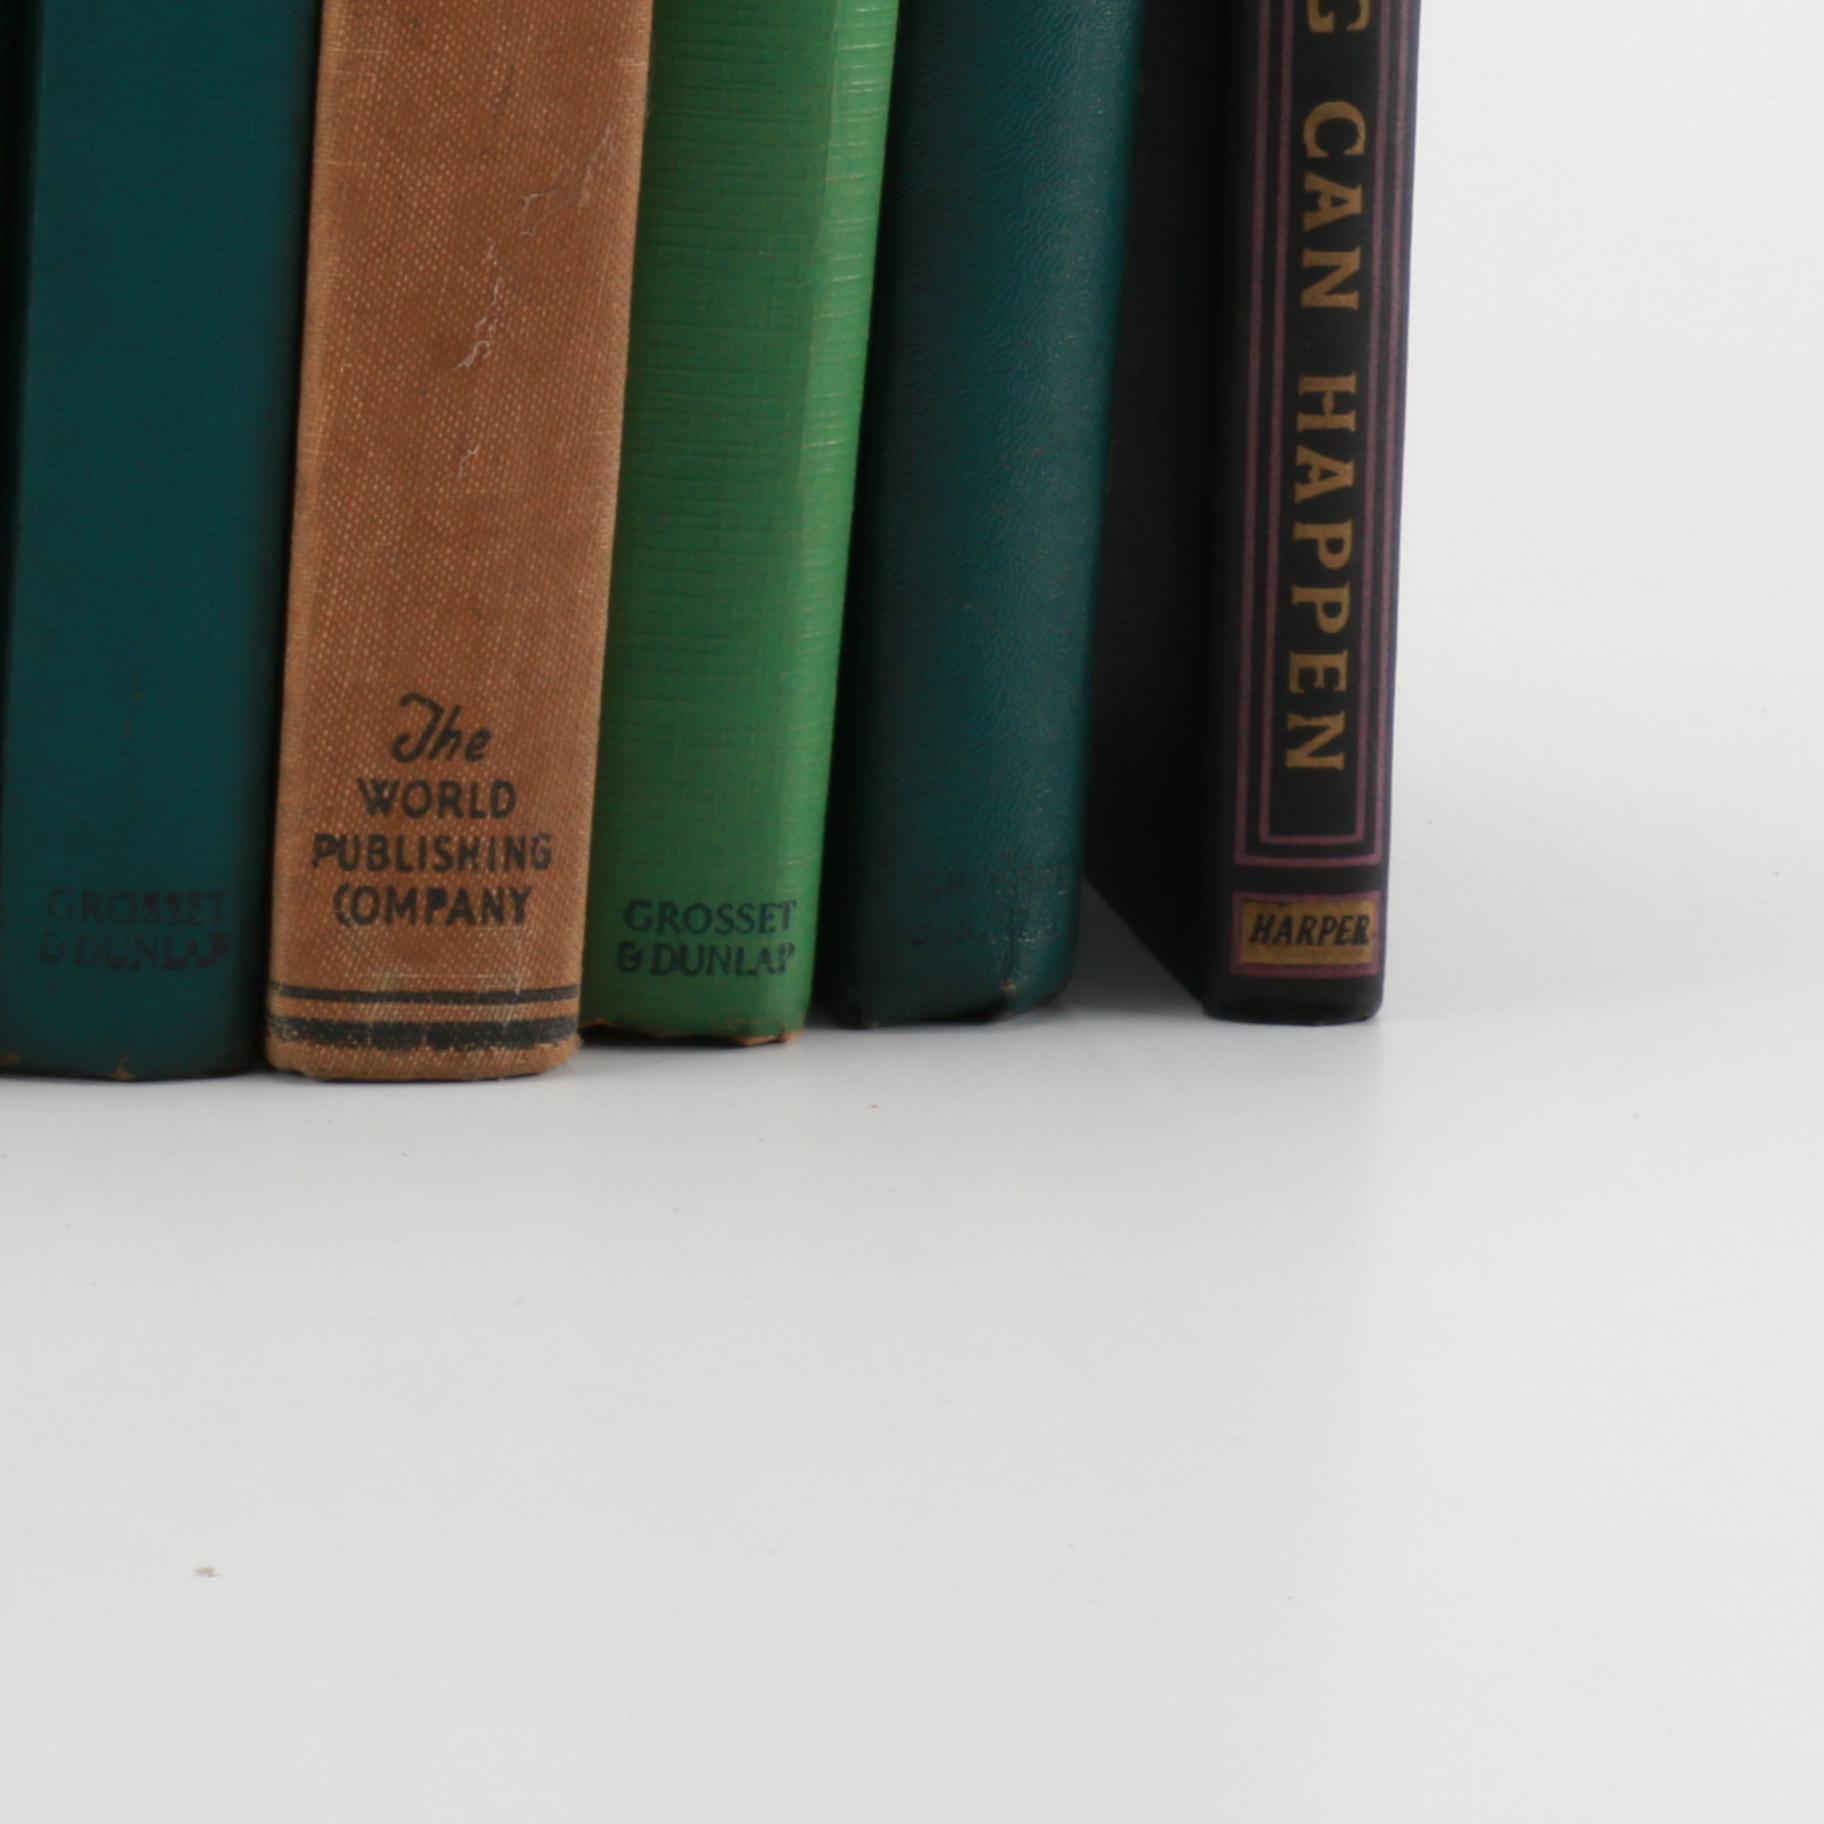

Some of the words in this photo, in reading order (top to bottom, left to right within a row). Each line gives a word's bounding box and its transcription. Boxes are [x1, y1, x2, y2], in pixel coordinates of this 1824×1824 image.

[1299, 100, 1366, 311] CAN
[1285, 375, 1358, 771] HAPPEN
[389, 692, 492, 763] The
[358, 777, 516, 819] WORLD
[312, 832, 552, 873] PUBLISHING
[48, 887, 229, 927] GROSSET
[333, 883, 532, 927] COMPANY
[624, 899, 798, 936] GROSSET
[1249, 914, 1370, 945] HARPER
